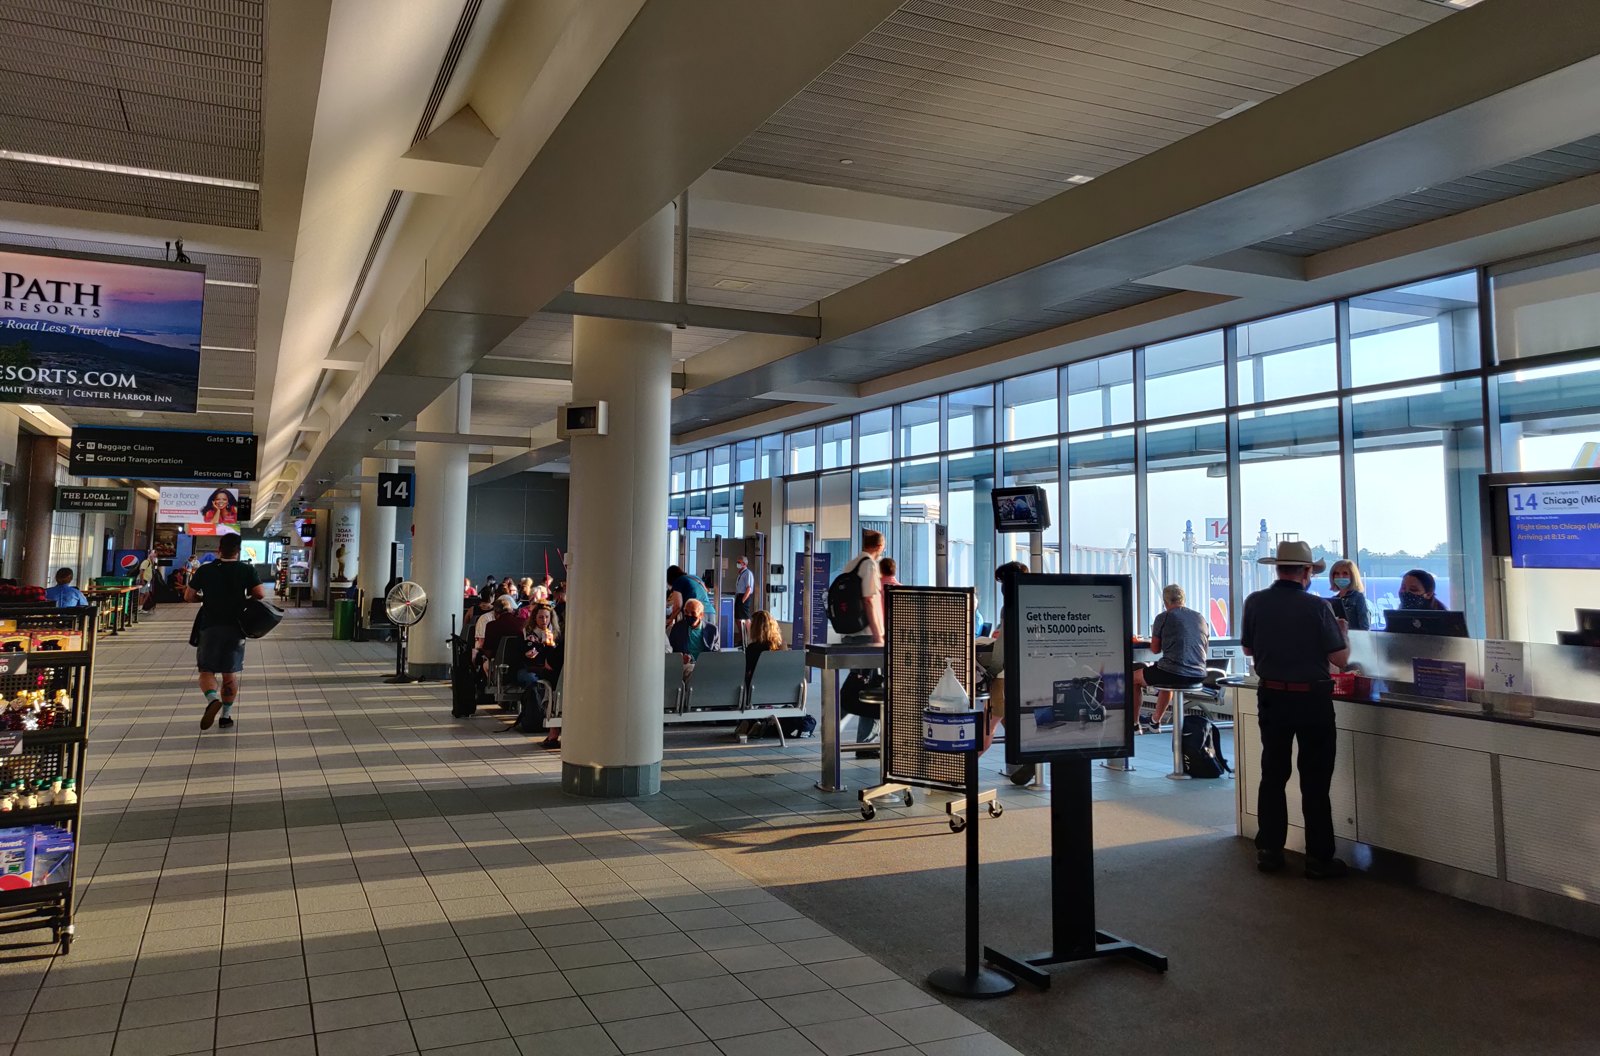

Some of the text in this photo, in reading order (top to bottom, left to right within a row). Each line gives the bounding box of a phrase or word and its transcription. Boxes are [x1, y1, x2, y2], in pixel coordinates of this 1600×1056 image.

[2, 271, 102, 307] PATH
[4, 301, 100, 318] RESORTS
[6, 319, 39, 331] Road
[41, 322, 67, 334] Less
[70, 324, 121, 338] Traveled
[97, 443, 132, 451] Baggage
[128, 455, 184, 465] Transportation
[193, 470, 232, 478] Restrooms
[161, 491, 172, 499] Be
[179, 491, 200, 499] force
[382, 480, 409, 500] 14
[83, 492, 111, 500] LOCAL
[1542, 496, 1579, 506] Chicago
[175, 499, 196, 507] good
[1513, 493, 1538, 511] 14
[752, 501, 762, 518] 14
[1516, 523, 1535, 531] Flight
[1559, 523, 1586, 531] Chicago
[1517, 533, 1543, 541] Arriving
[1026, 611, 1091, 621] Get there faster
[1026, 624, 1105, 635] with 50,000 points.
